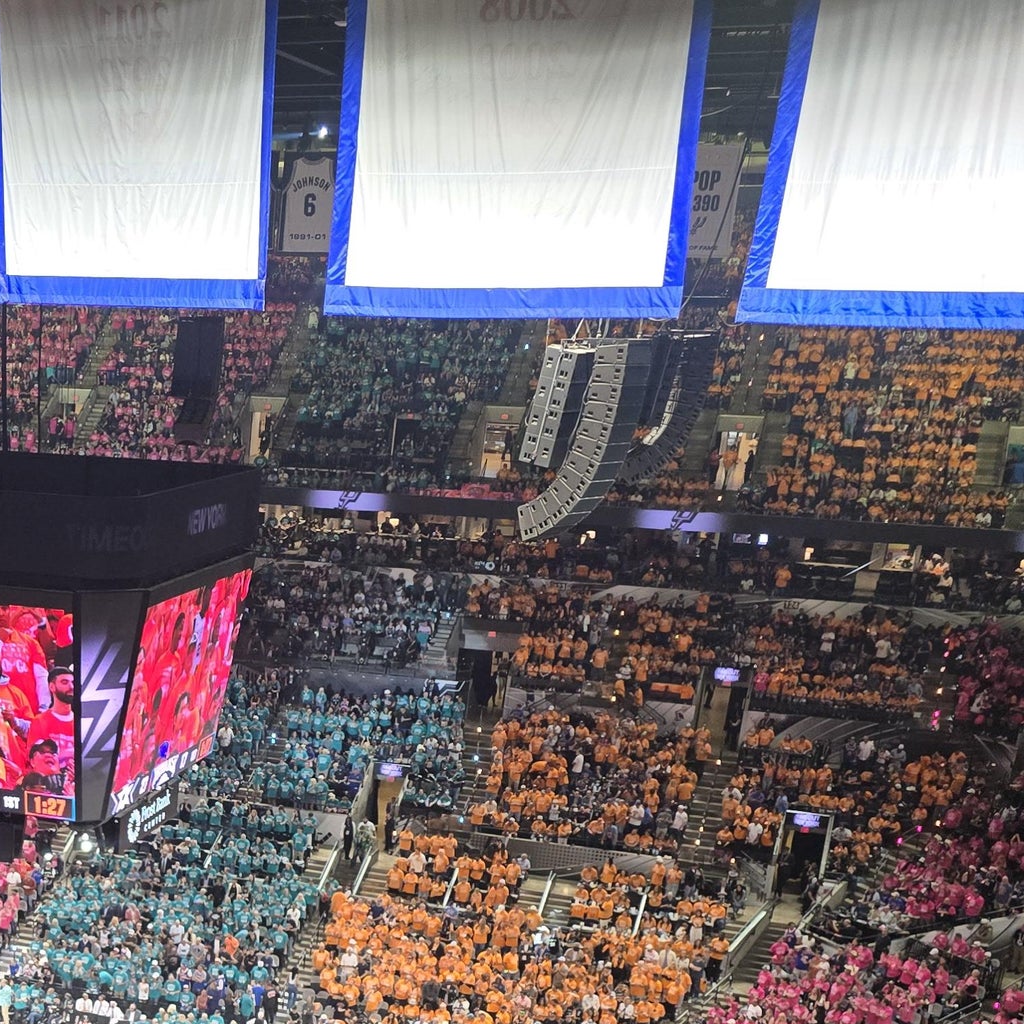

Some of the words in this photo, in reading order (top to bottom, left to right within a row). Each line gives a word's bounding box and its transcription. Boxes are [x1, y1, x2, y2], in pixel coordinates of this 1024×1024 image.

[292, 176, 331, 193] JOHNSON
[304, 193, 317, 217] 6
[187, 510, 206, 536] NEW
[3, 795, 21, 810] 1ST
[33, 796, 66, 816] 1:27
